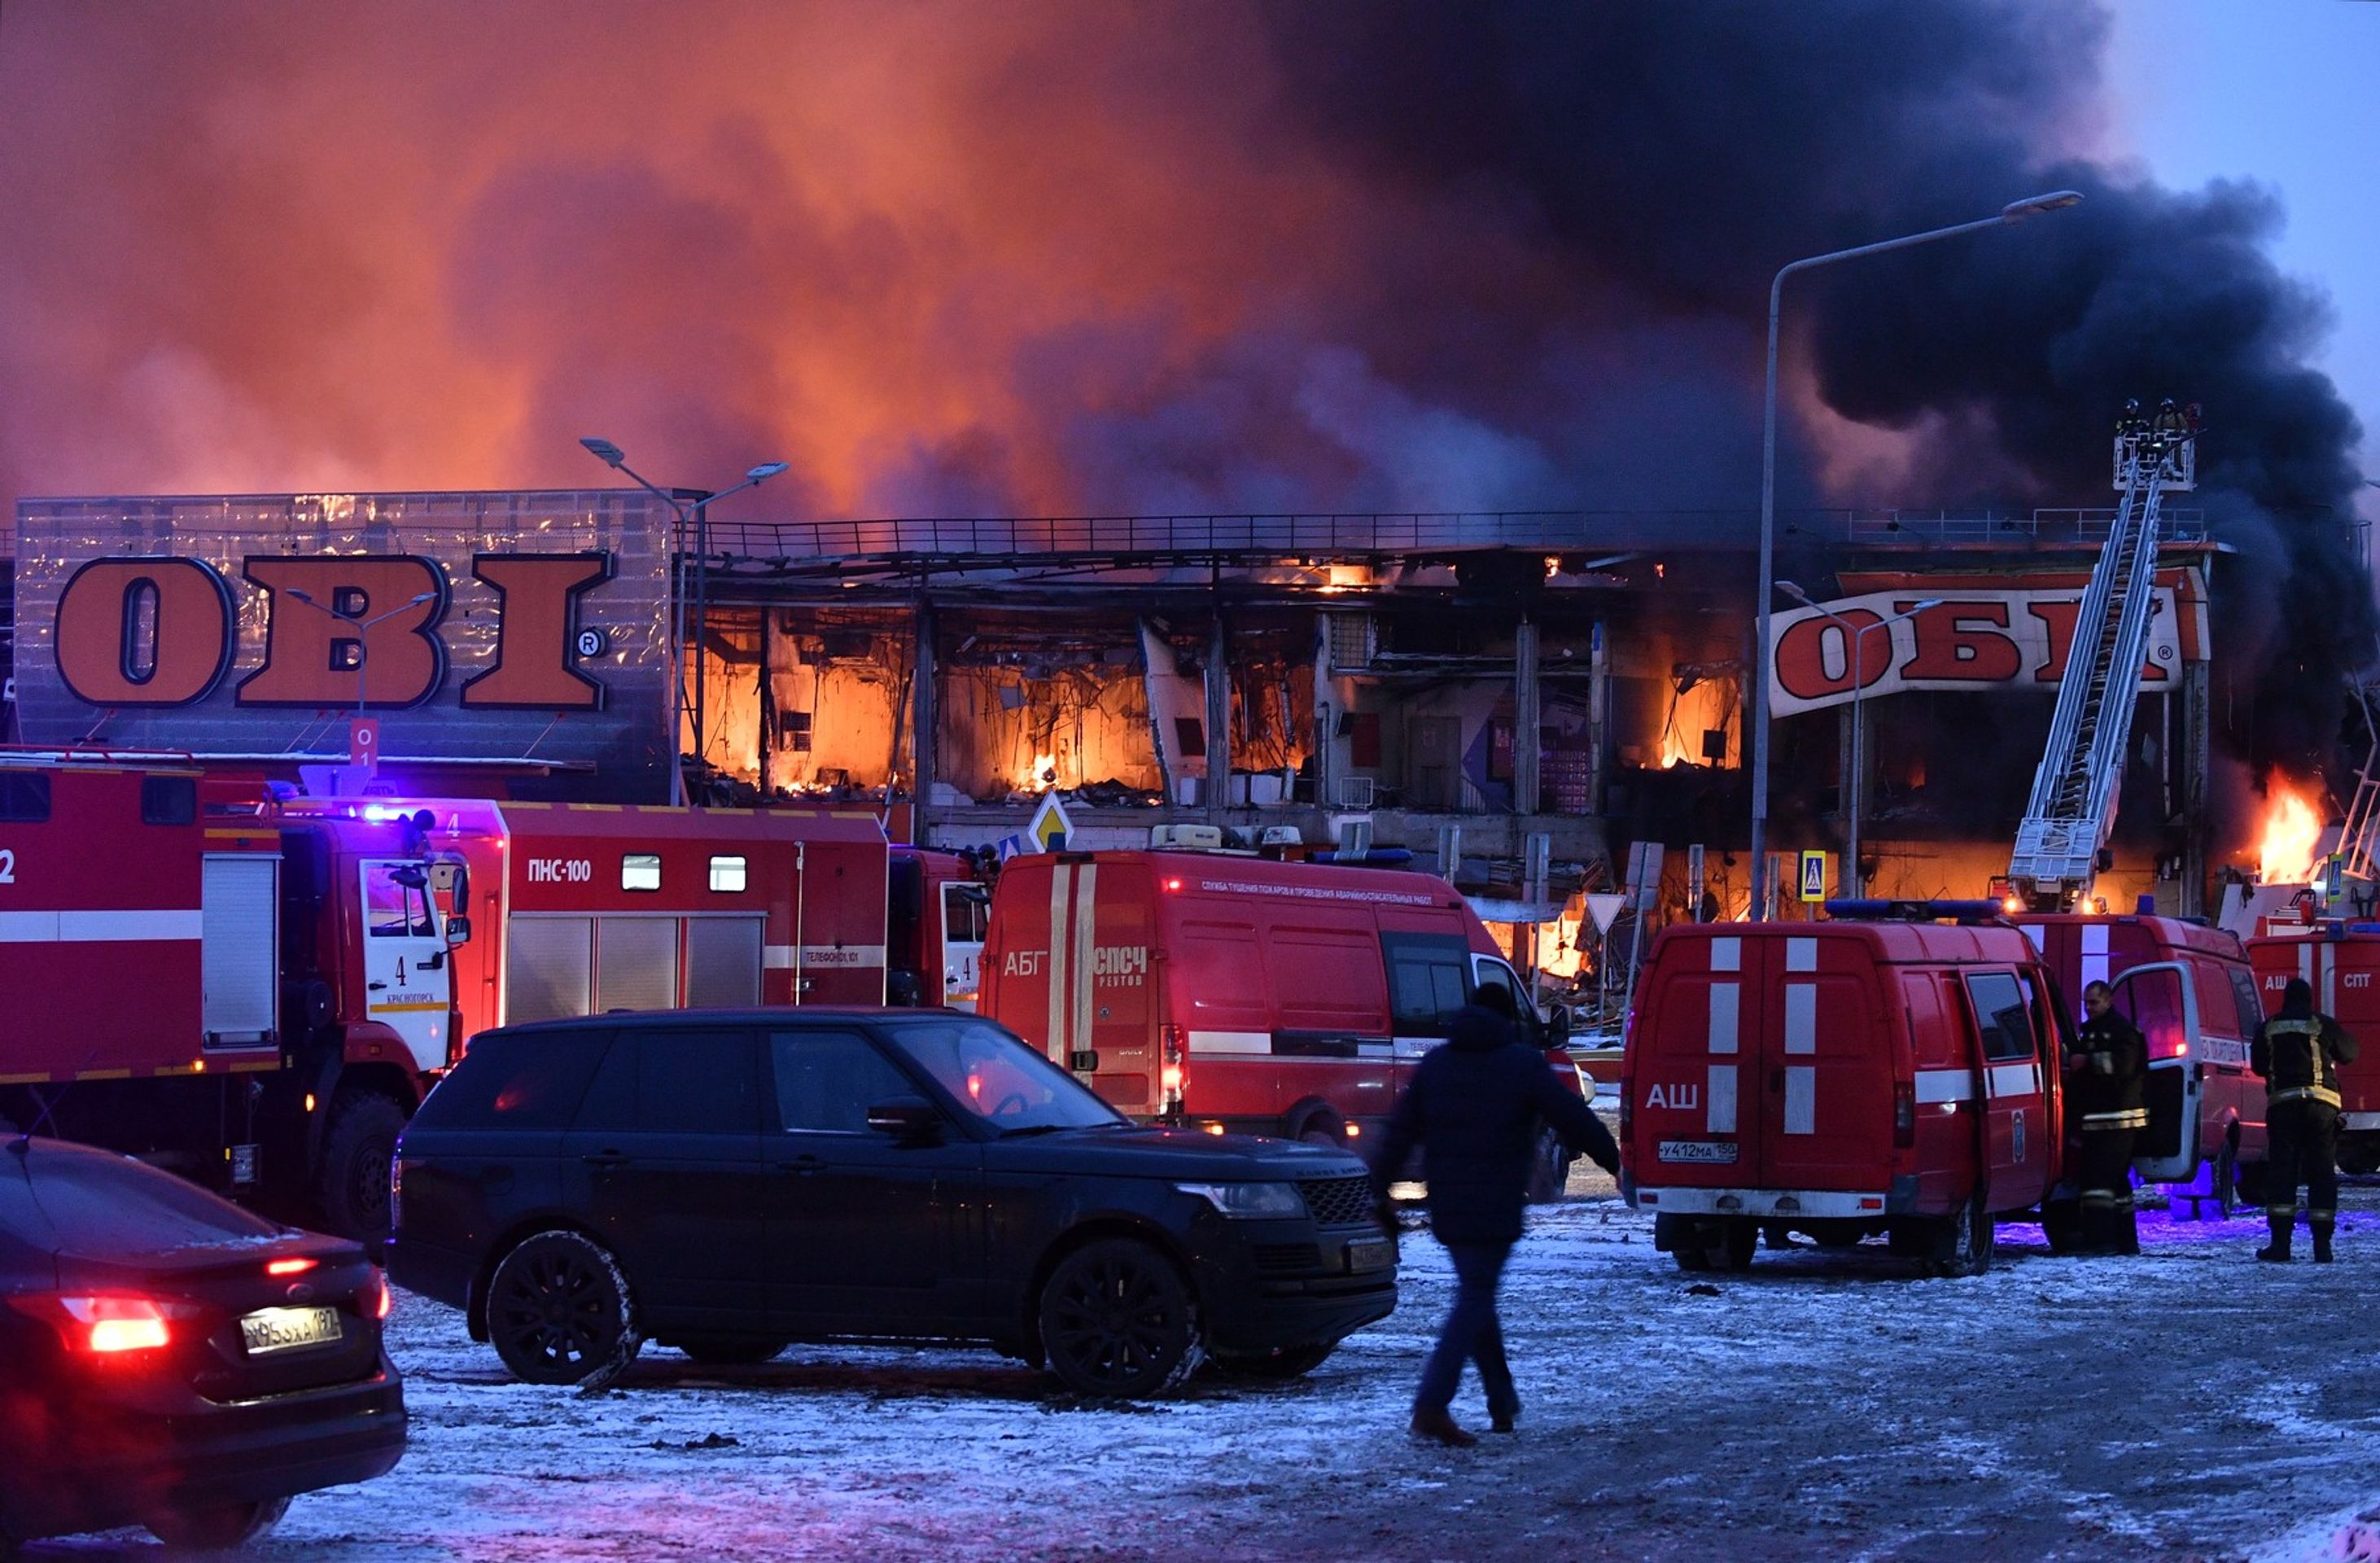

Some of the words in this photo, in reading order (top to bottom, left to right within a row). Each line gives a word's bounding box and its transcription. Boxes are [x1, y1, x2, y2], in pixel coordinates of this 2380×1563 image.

[54, 554, 615, 710] OBI
[528, 859, 591, 882] ПНС-100
[806, 952, 839, 963] ТЕЛЕФОН
[964, 957, 970, 981] 4
[1004, 951, 1048, 976] АБГ
[1092, 946, 1147, 975] СПСЧ
[396, 956, 406, 987] 4
[1100, 975, 1142, 987] РЕУТОВ
[2264, 975, 2287, 990] АШ
[2344, 973, 2370, 987] СПТ
[387, 992, 435, 1004] КРАСНОГОРСК
[1645, 1084, 1698, 1109] АШ
